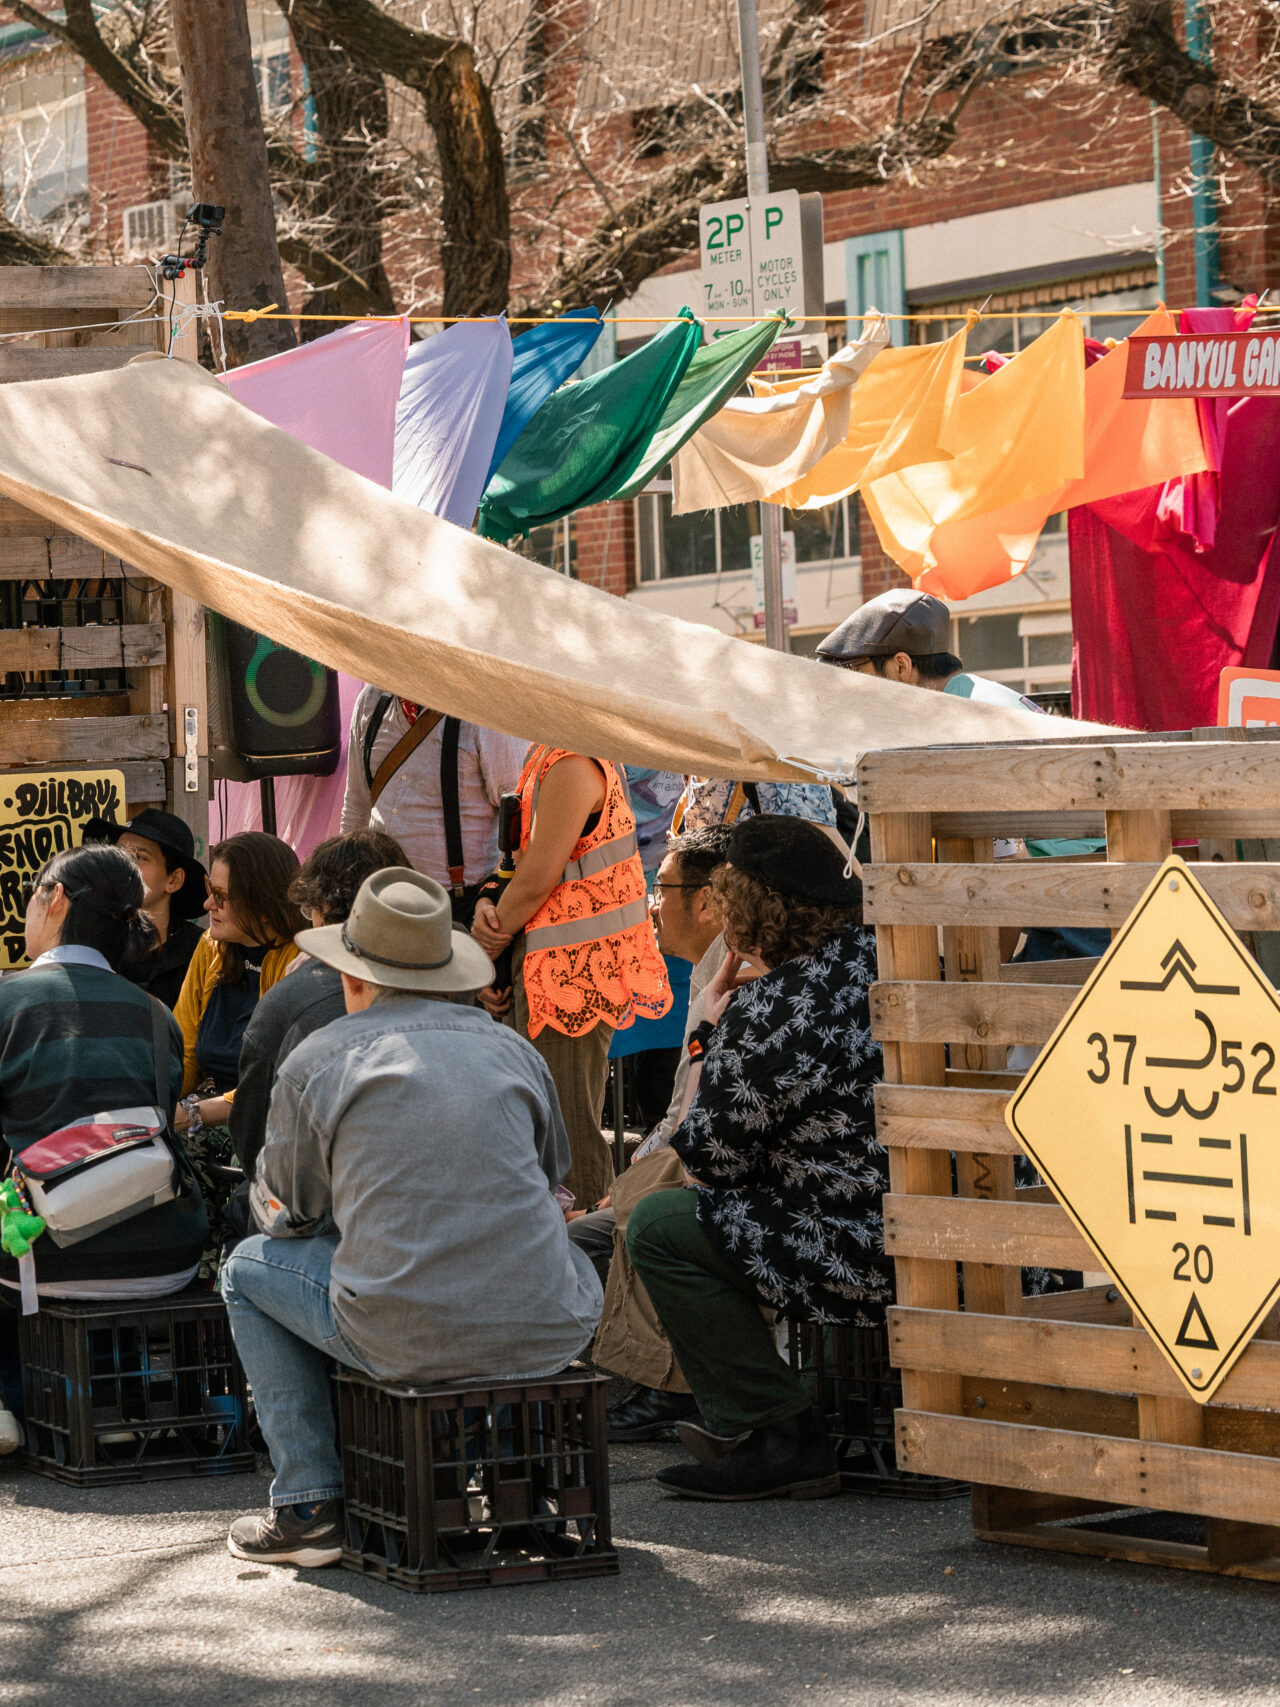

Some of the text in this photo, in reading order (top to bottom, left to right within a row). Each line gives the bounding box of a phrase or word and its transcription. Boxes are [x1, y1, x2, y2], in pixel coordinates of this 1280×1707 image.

[706, 213, 744, 250] 2P
[765, 206, 783, 240] P
[710, 249, 742, 266] METER
[760, 257, 793, 273] MOTOR
[757, 270, 798, 288] CYCLES
[708, 300, 725, 311] MON
[732, 296, 748, 307] SUN
[763, 286, 791, 301] ONLY
[1143, 339, 1237, 390] BANYUL
[1086, 1032, 1277, 1095] 37 52
[1172, 1242, 1214, 1284] 20
